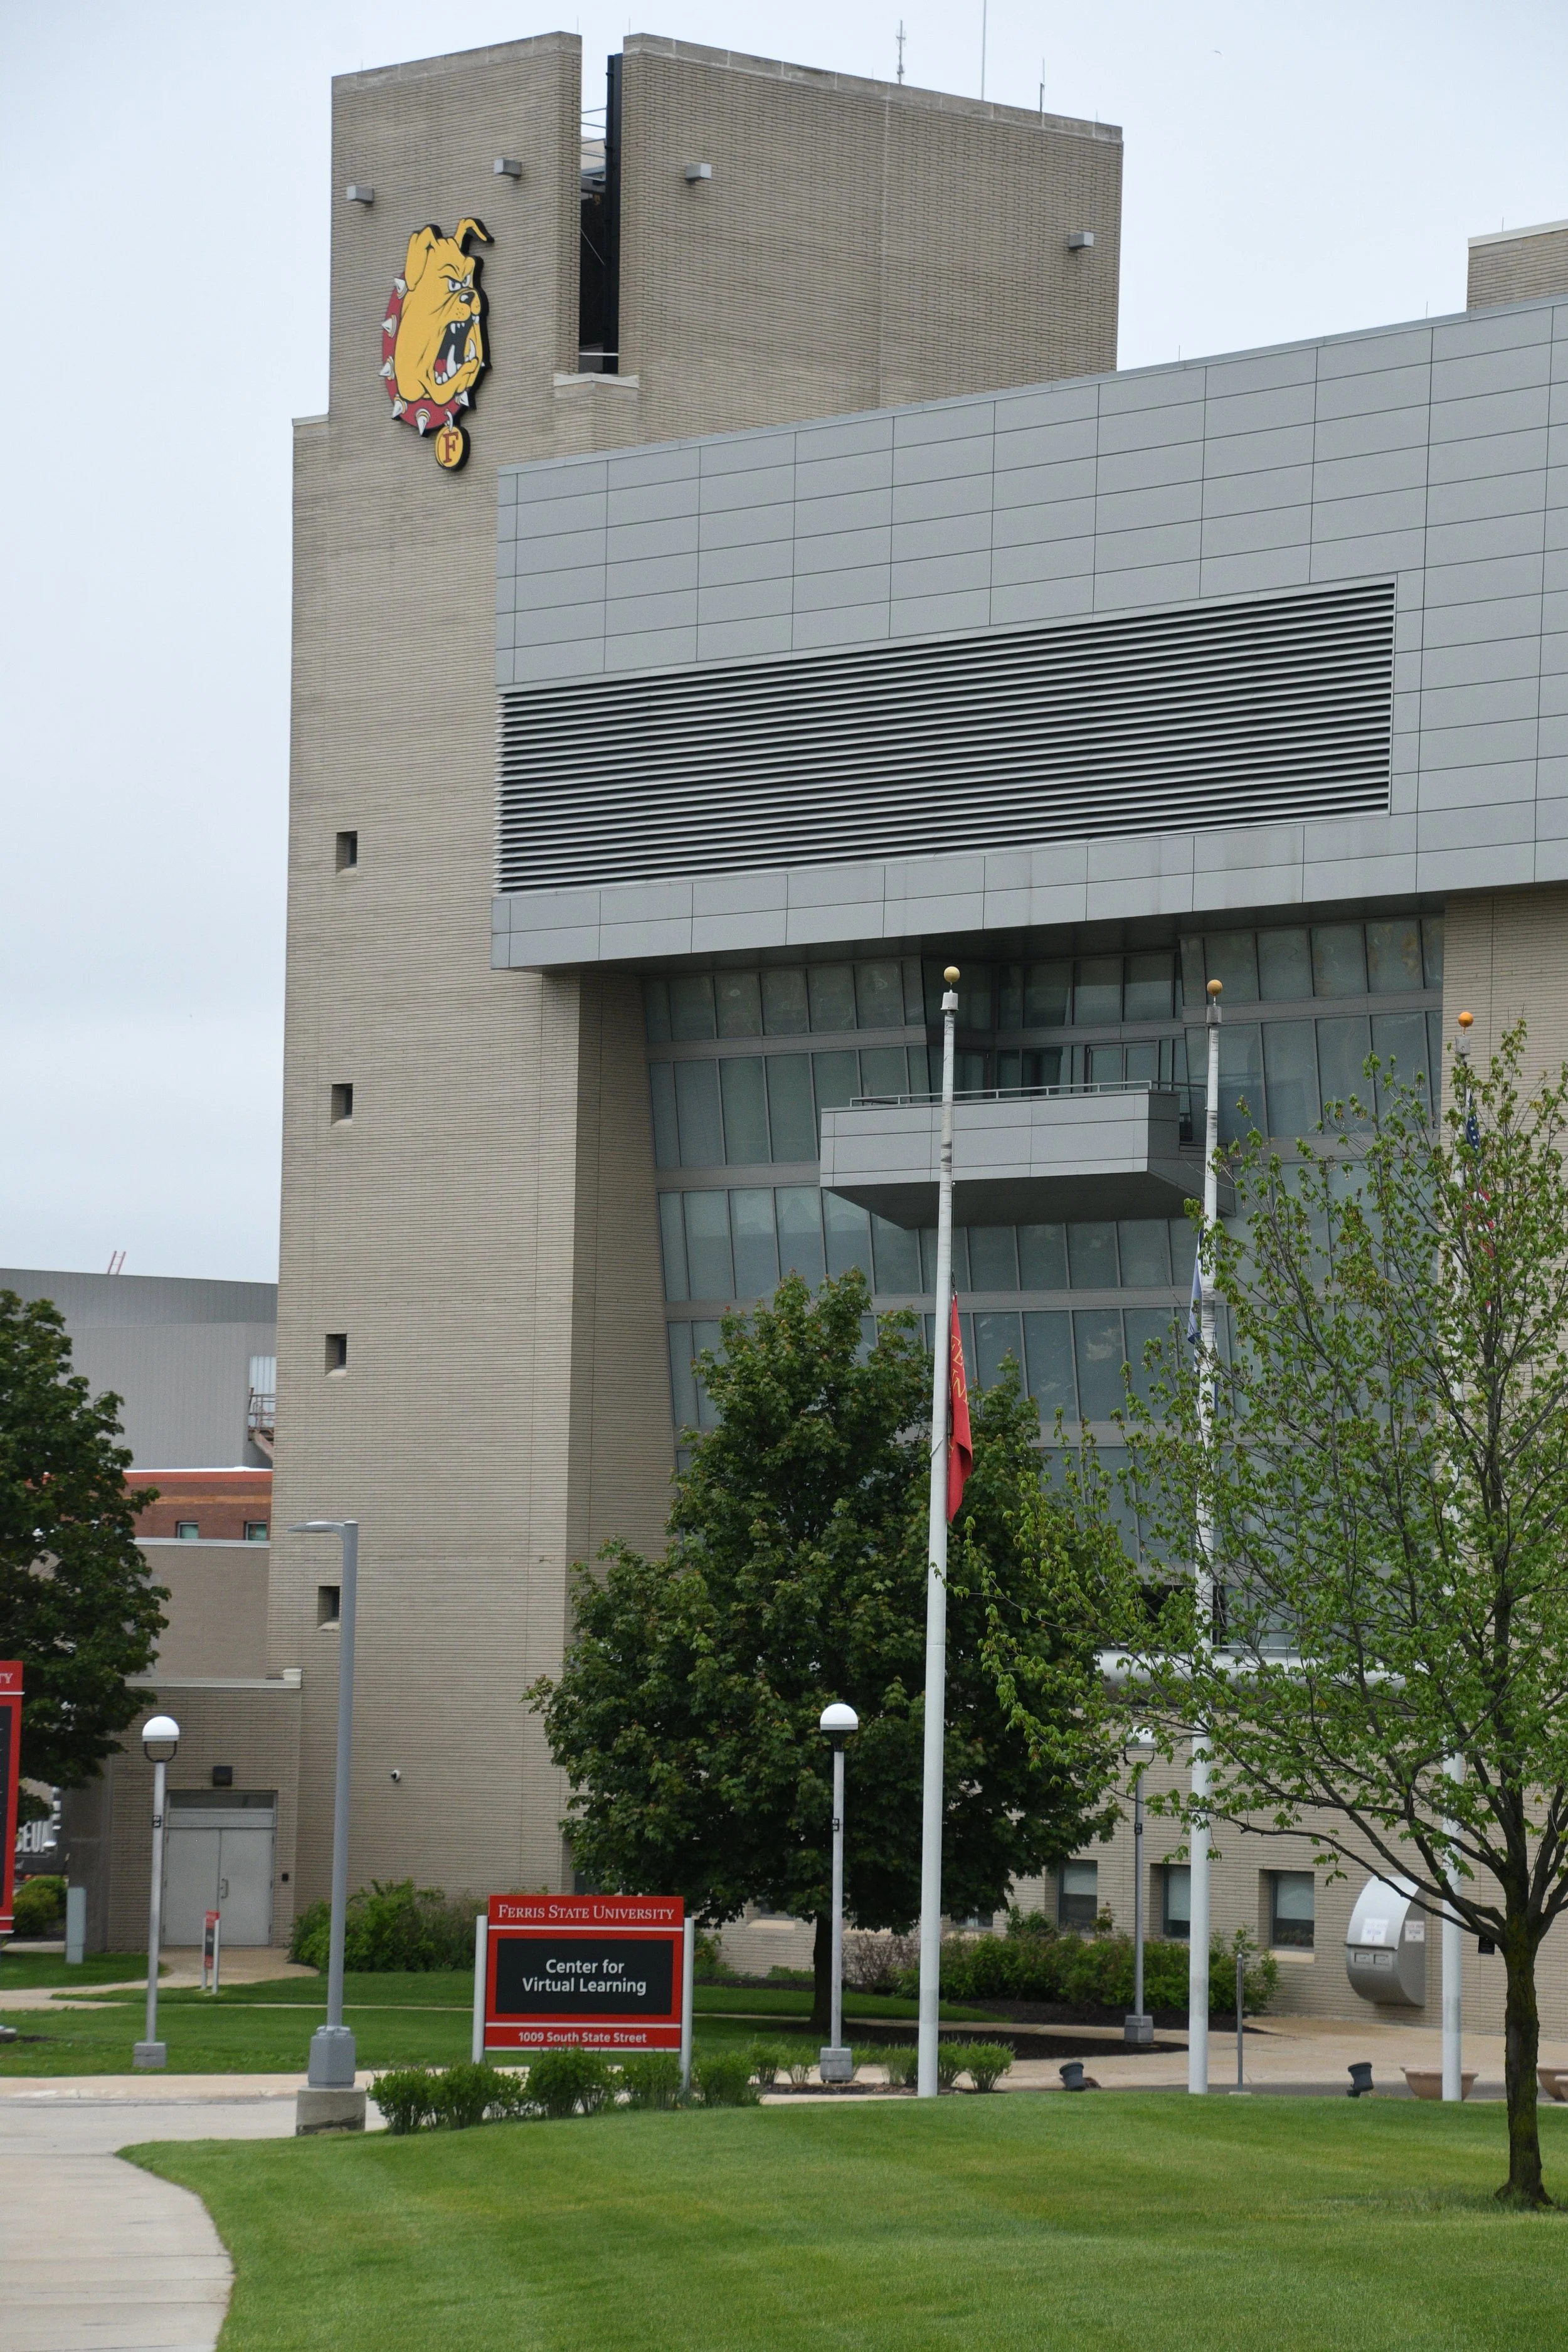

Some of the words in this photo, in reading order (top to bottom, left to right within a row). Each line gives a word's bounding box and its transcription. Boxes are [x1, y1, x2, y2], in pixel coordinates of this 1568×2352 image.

[443, 432, 458, 464] F
[498, 1904, 545, 1919] FERRIS
[548, 1904, 590, 1919] STATE
[593, 1905, 674, 1920] UNIVERSITY
[546, 1959, 598, 1974] Center
[602, 1959, 625, 1974] for
[522, 1976, 575, 1992] Virtual
[580, 1977, 647, 1996] Learning
[518, 2032, 544, 2042] 1009
[546, 2032, 579, 2043] South
[581, 2032, 611, 2043] State
[613, 2032, 647, 2043] Street
